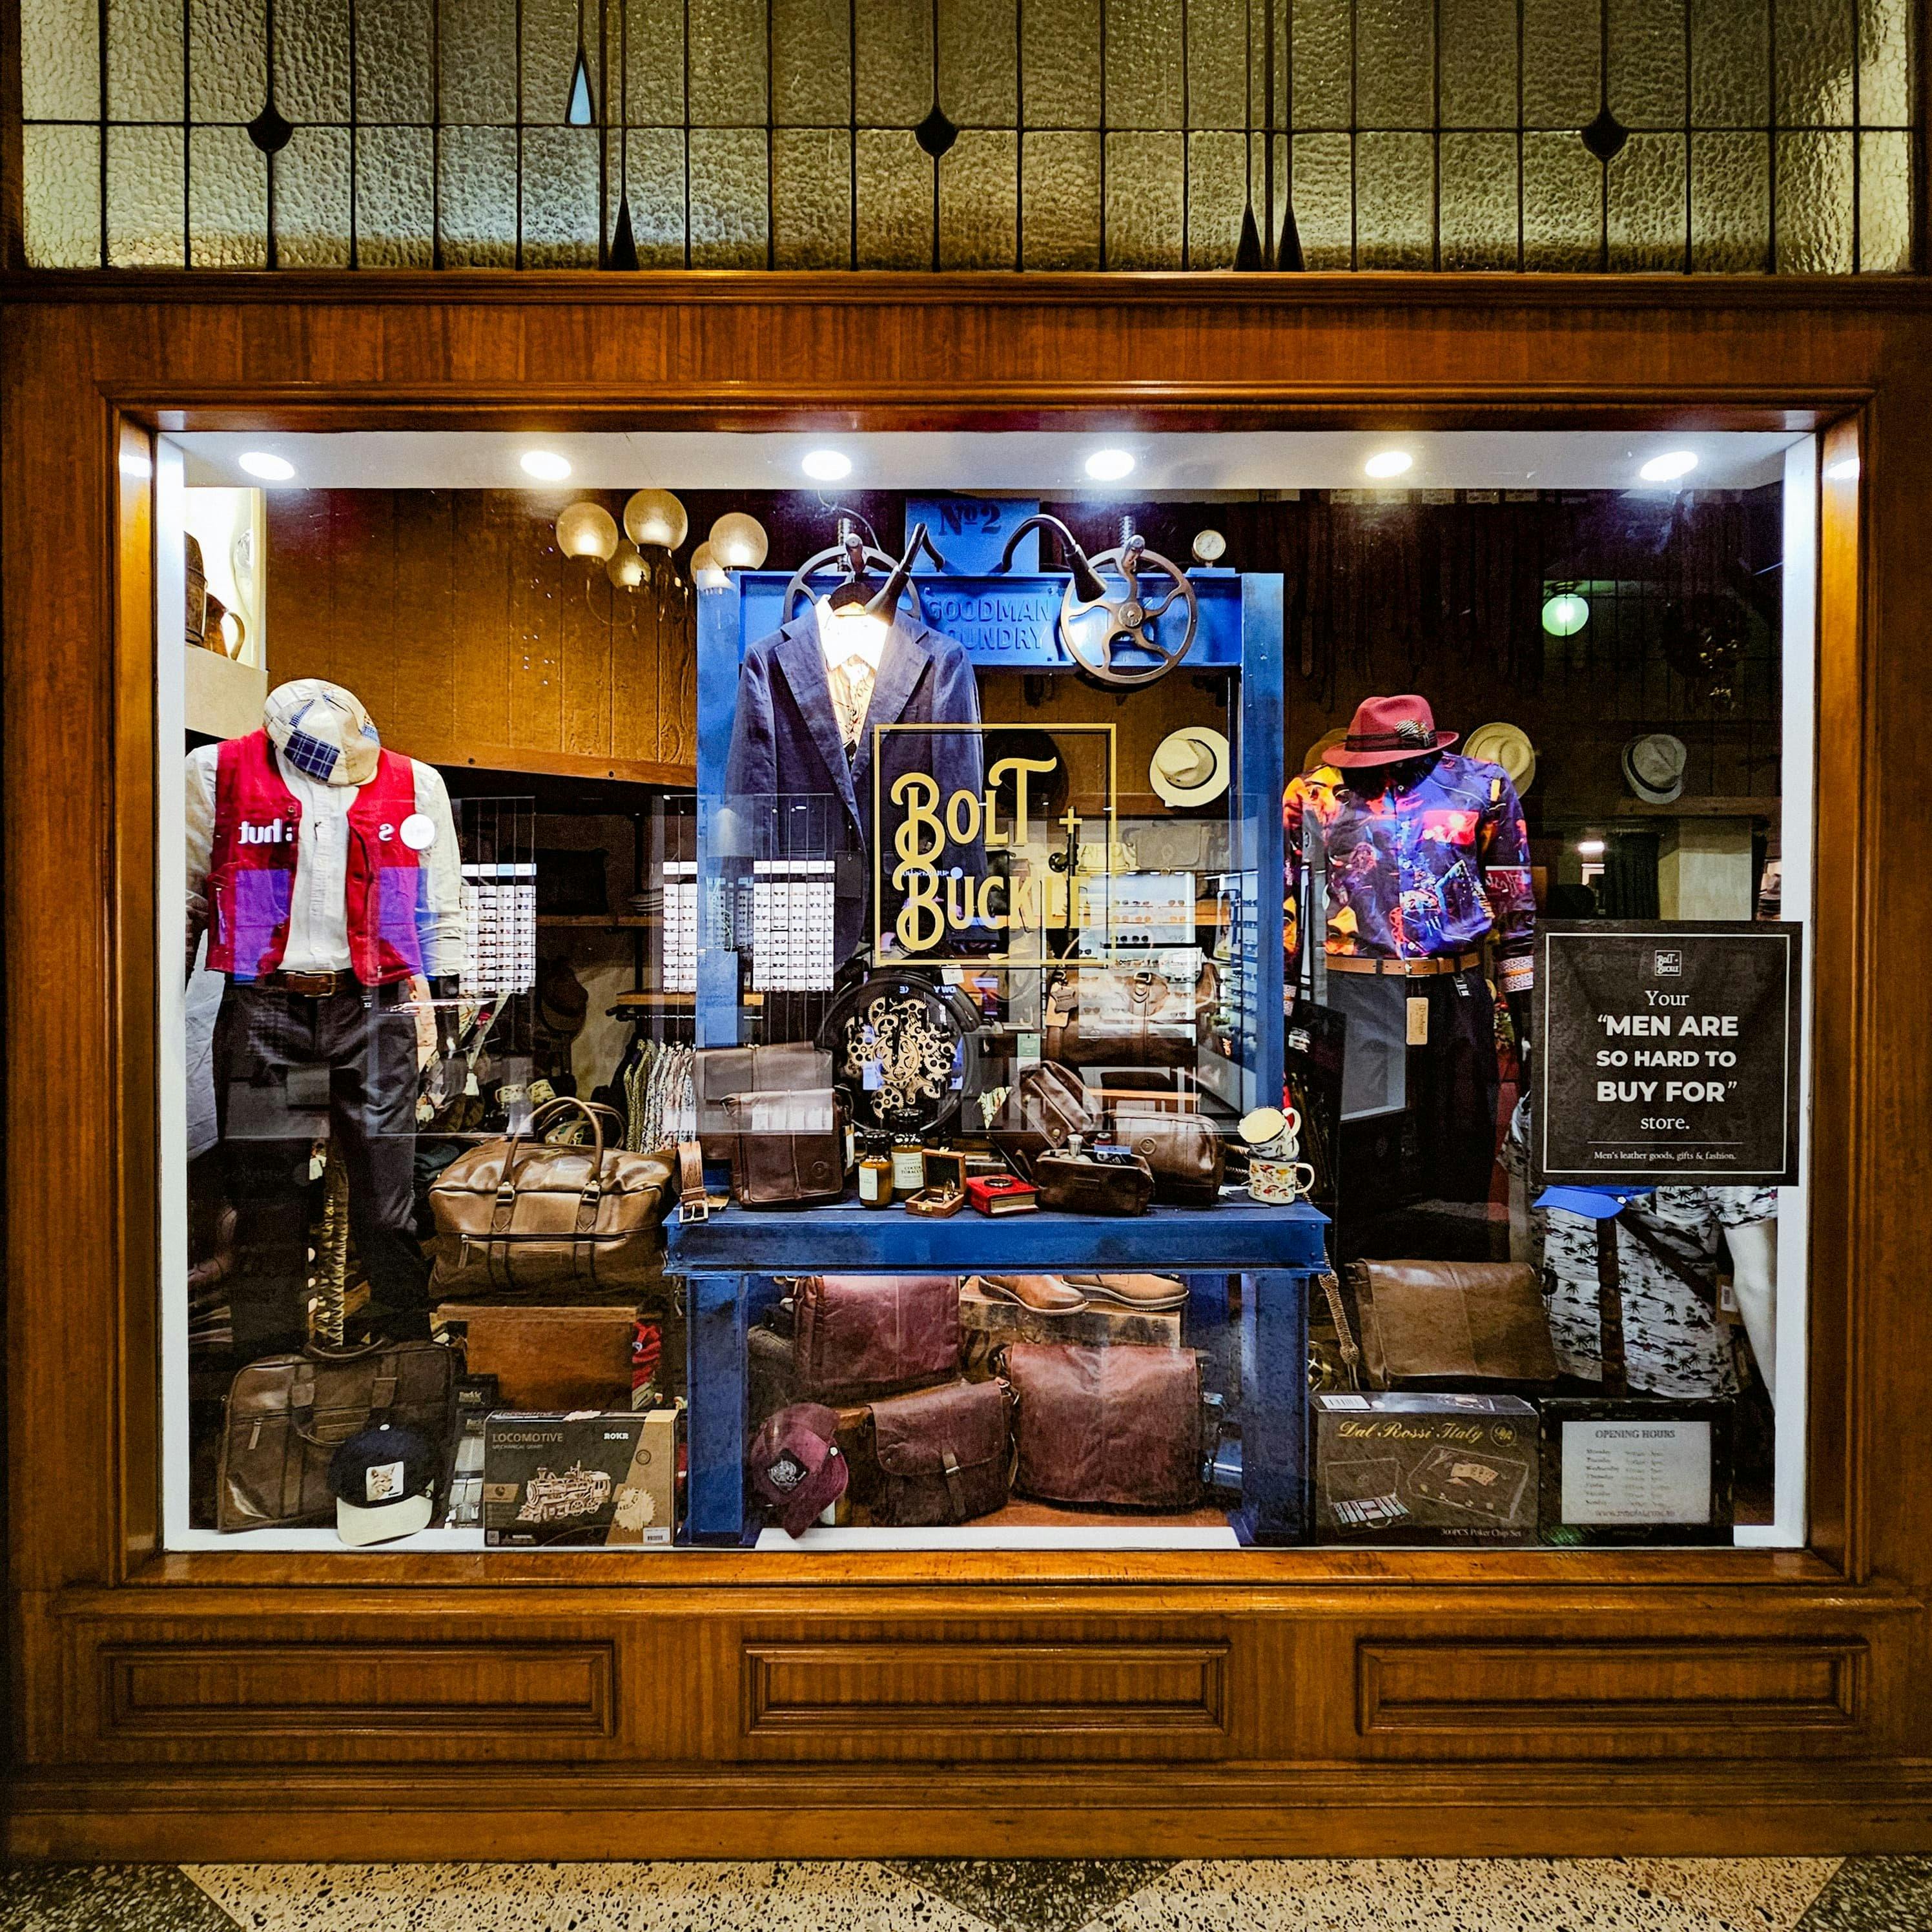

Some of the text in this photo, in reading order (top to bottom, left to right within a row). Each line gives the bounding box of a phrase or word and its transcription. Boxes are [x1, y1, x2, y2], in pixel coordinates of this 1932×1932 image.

[928, 599, 1051, 622] GOODMAN
[947, 627, 1047, 650] OUNDRY
[1644, 990, 1690, 1007] Your
[1597, 1014, 1739, 1036] “MEN ARE
[1596, 1050, 1737, 1067] SO HARD TO
[1597, 1081, 1737, 1102] BUY FOR”
[1640, 1116, 1690, 1130] store.
[1619, 1151, 1647, 1160] leather
[1649, 1151, 1674, 1161] goods,
[1677, 1151, 1694, 1161] gifts
[1705, 1151, 1736, 1160] fashion.
[492, 1433, 564, 1443] LOCOMOTIVE
[1337, 1421, 1484, 1443] Dal Rossi Italy
[1596, 1429, 1676, 1439] OPENING HOURS
